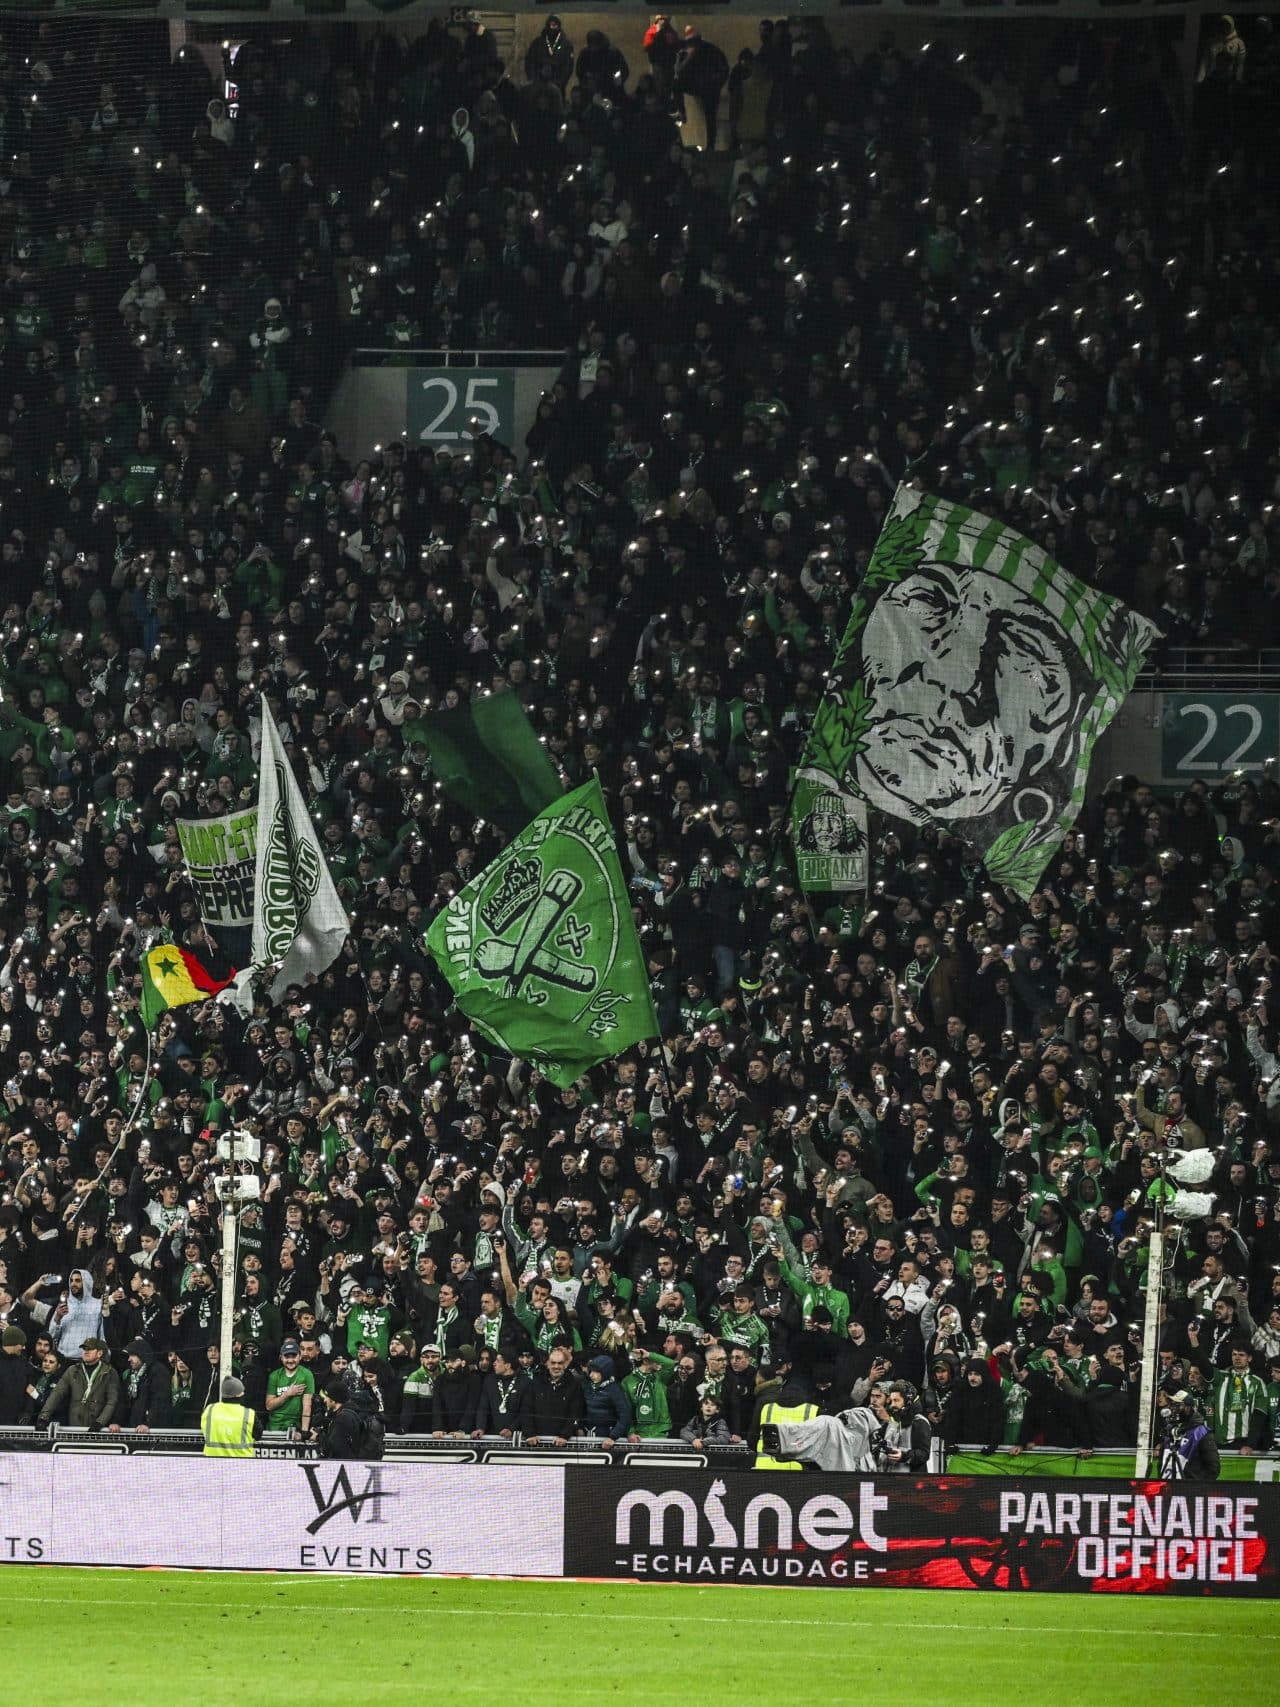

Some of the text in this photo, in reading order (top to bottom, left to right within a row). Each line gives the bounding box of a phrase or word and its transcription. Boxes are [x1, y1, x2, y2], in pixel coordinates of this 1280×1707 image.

[421, 378, 499, 441] 25
[1176, 704, 1264, 771] 22
[213, 859, 256, 881] CONTR
[191, 879, 255, 921] REPRE
[999, 1491, 1259, 1539] PARTENAIRE
[300, 1545, 433, 1570] EVENTS
[1077, 1536, 1259, 1582] OFFICIEL
